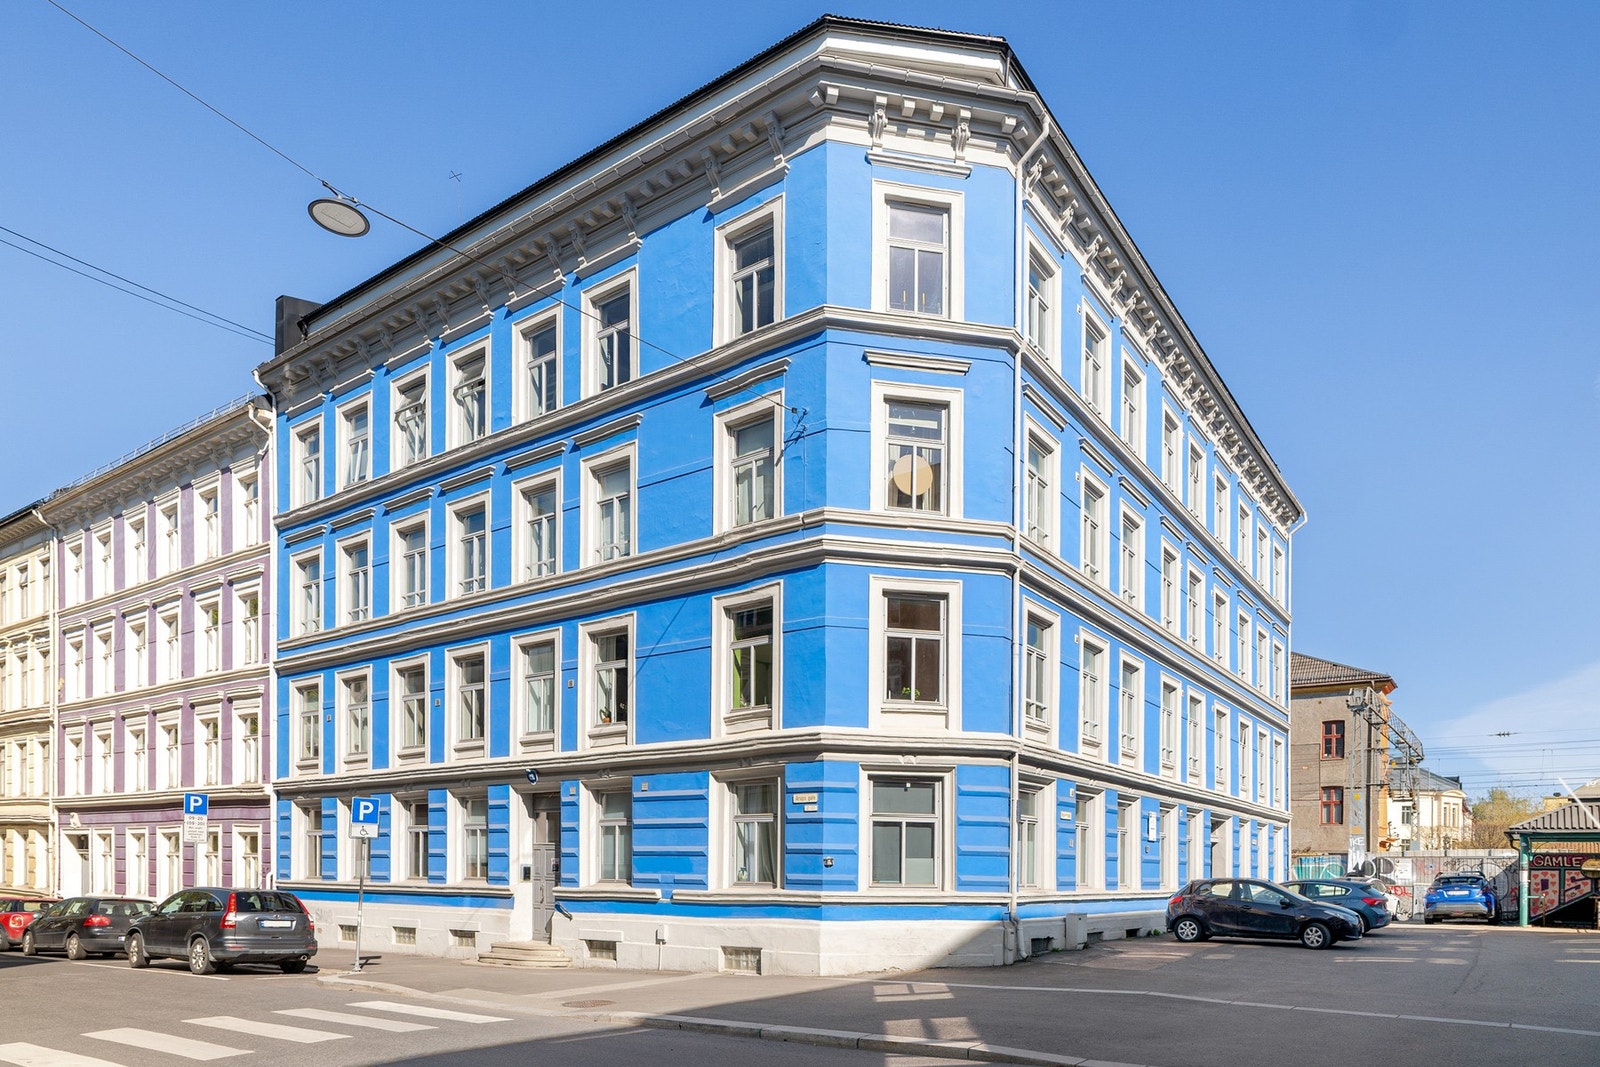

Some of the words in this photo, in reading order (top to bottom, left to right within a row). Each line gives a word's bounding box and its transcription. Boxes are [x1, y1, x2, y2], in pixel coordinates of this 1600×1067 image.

[190, 796, 203, 812] P
[359, 801, 374, 821] P
[1533, 854, 1583, 867] GAMLE
